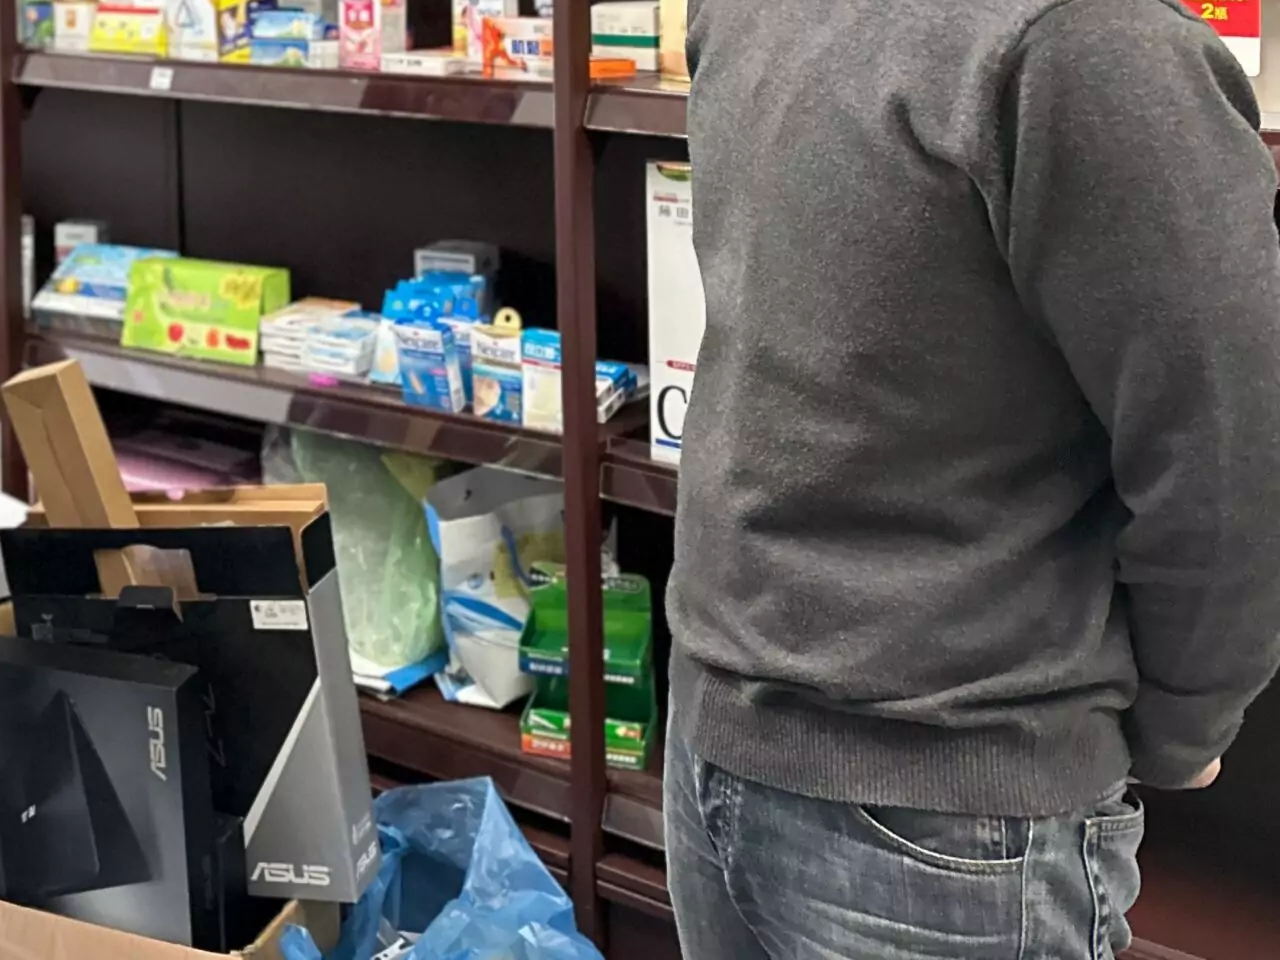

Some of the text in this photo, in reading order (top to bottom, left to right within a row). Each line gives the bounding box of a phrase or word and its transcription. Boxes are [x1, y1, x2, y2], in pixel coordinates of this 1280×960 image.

[1201, 3, 1228, 20] 2瓶
[147, 706, 168, 781] ASUS
[251, 862, 331, 886] ASUS
